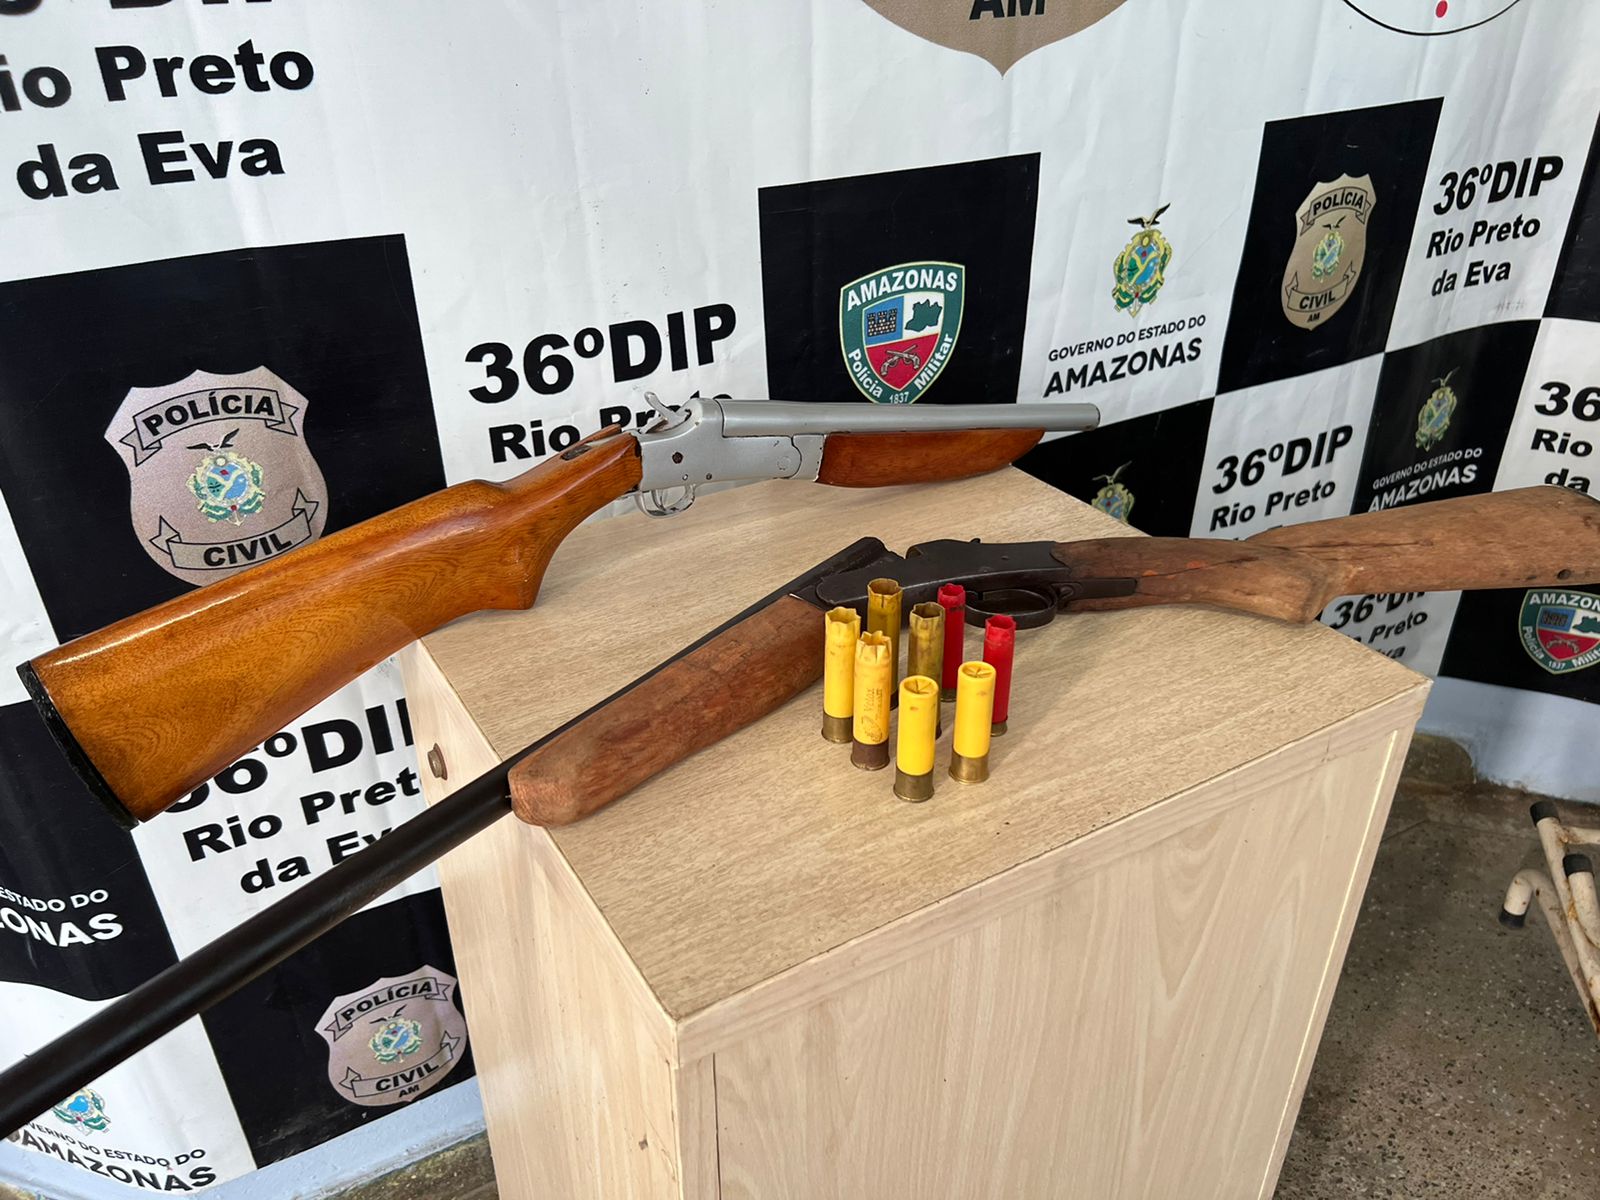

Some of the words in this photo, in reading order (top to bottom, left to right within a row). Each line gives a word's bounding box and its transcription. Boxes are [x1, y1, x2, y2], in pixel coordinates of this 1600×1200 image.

[0, 54, 72, 112] io
[95, 39, 315, 102] Preto
[16, 143, 119, 200] da
[137, 130, 285, 185] Eva
[1433, 156, 1563, 215] 36ºDIP
[1313, 188, 1364, 216] POLÍCIA
[1426, 228, 1464, 259] Rio
[1468, 213, 1541, 247] Preto
[847, 269, 958, 311] AMAZONAS
[1431, 269, 1457, 296] da
[1464, 260, 1511, 287] Eva
[1299, 291, 1336, 309] CIVIL
[1307, 313, 1320, 322] AM
[465, 303, 737, 404] 36ºDIP
[1048, 337, 1113, 362] GOVERNO
[1116, 331, 1135, 346] DO
[1138, 320, 1185, 340] ESTADO
[1188, 314, 1206, 328] DO
[914, 333, 953, 390] Militar
[1043, 337, 1202, 398] AMAZONAS
[142, 391, 276, 437] POLÍCIA
[889, 391, 909, 404] 1837
[1534, 381, 1600, 422] 36
[489, 419, 581, 463] Rio
[1212, 425, 1353, 495] 36ºDIP
[1531, 428, 1593, 457] Rio
[1368, 464, 1478, 513] AMAZONAS
[1372, 466, 1412, 490] GOVERNO
[1413, 462, 1427, 474] DO
[1428, 450, 1462, 468] ESTADO
[1464, 447, 1482, 459] DO
[1544, 468, 1590, 493] da
[1209, 502, 1255, 532] Rio
[1263, 480, 1336, 516] Preto
[203, 532, 293, 567] CIVIL
[1368, 611, 1428, 643] Preto
[183, 815, 283, 862] Rio
[299, 767, 422, 826] Pret
[241, 856, 311, 894] da
[70, 889, 109, 909] DO
[0, 907, 123, 947] ONAS
[340, 981, 433, 1022] POLÍCIA
[375, 1062, 439, 1092] CIVIL
[398, 1084, 420, 1098] AM
[21, 1129, 217, 1191] AMAZONAS
[77, 1140, 101, 1155] DO
[103, 1148, 171, 1168] ESTADO
[175, 1149, 206, 1166] DO
